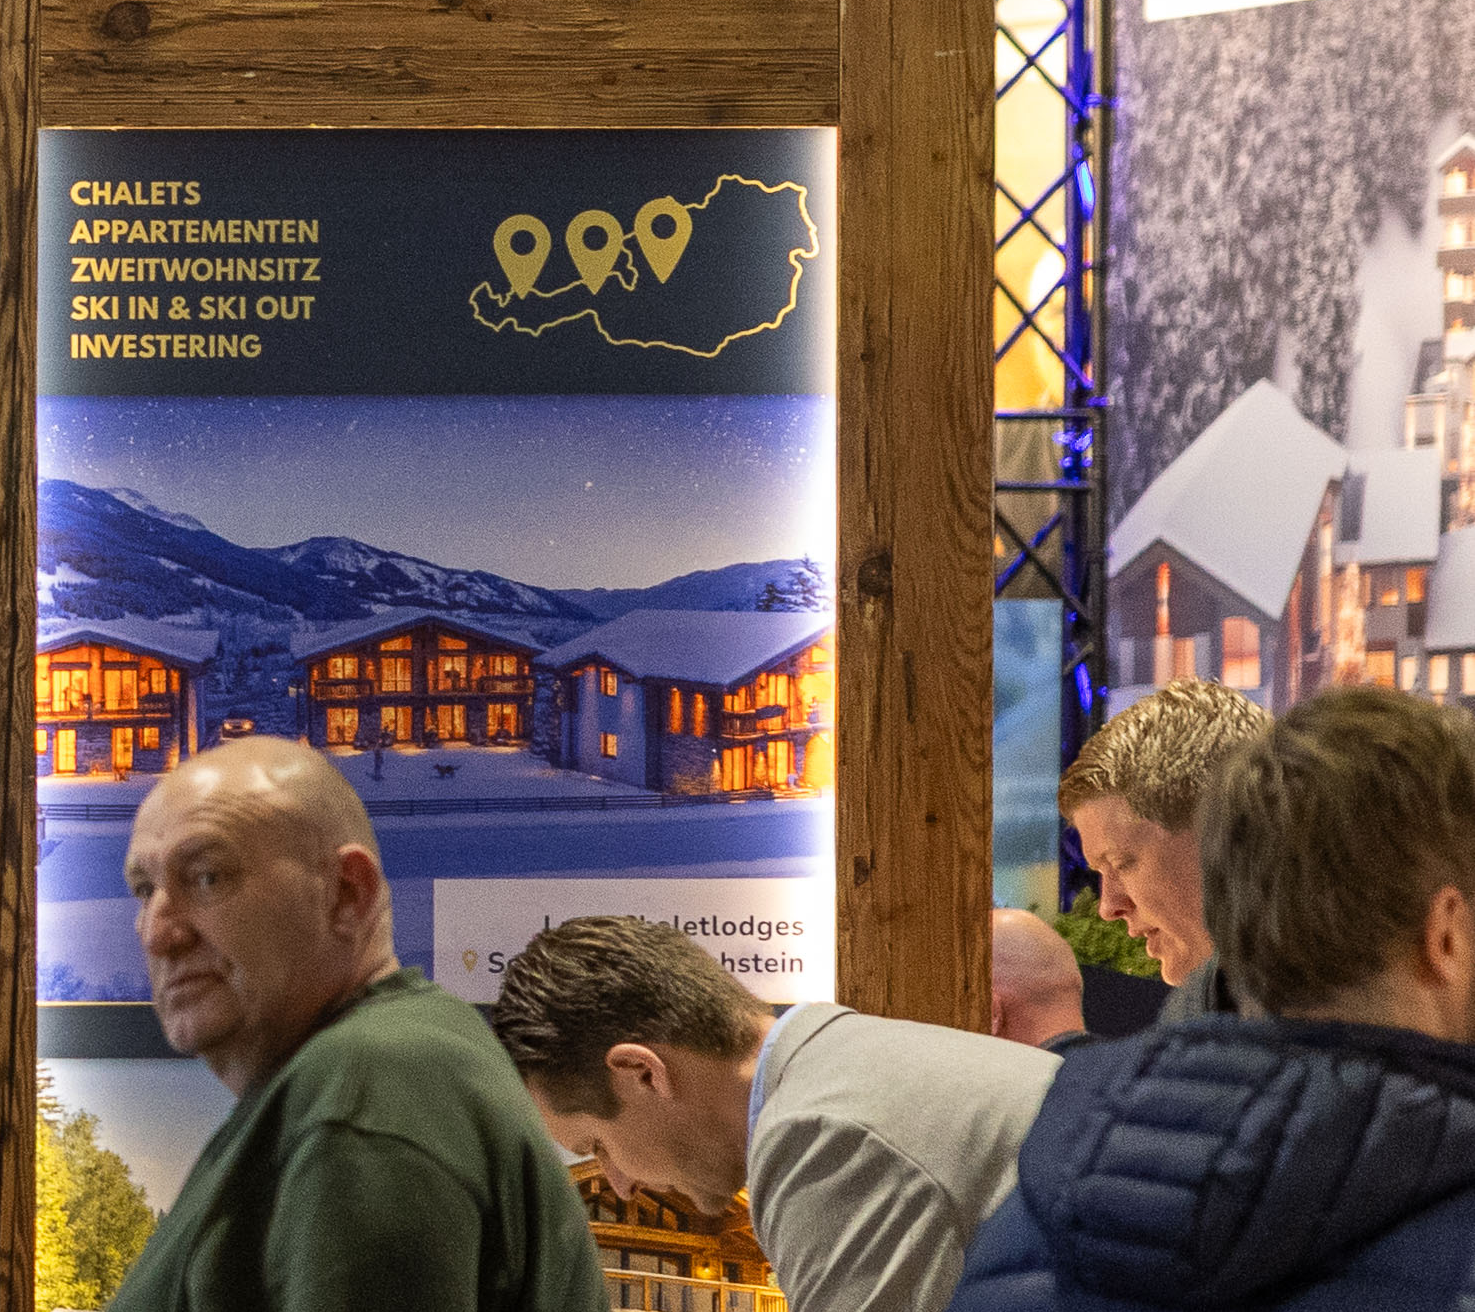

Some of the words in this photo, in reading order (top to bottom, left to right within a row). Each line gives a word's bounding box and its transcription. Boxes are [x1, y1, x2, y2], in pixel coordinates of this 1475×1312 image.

[70, 179, 202, 207] CHALETS
[70, 218, 321, 245] APPARTEMENTEN
[70, 257, 323, 284] ZWEITWOHNSITZ
[70, 295, 122, 322] SKI
[128, 295, 160, 322] IN
[168, 295, 192, 322] &
[198, 295, 248, 322] SKI
[254, 295, 316, 321] OUT
[70, 334, 264, 359] INVESTERING
